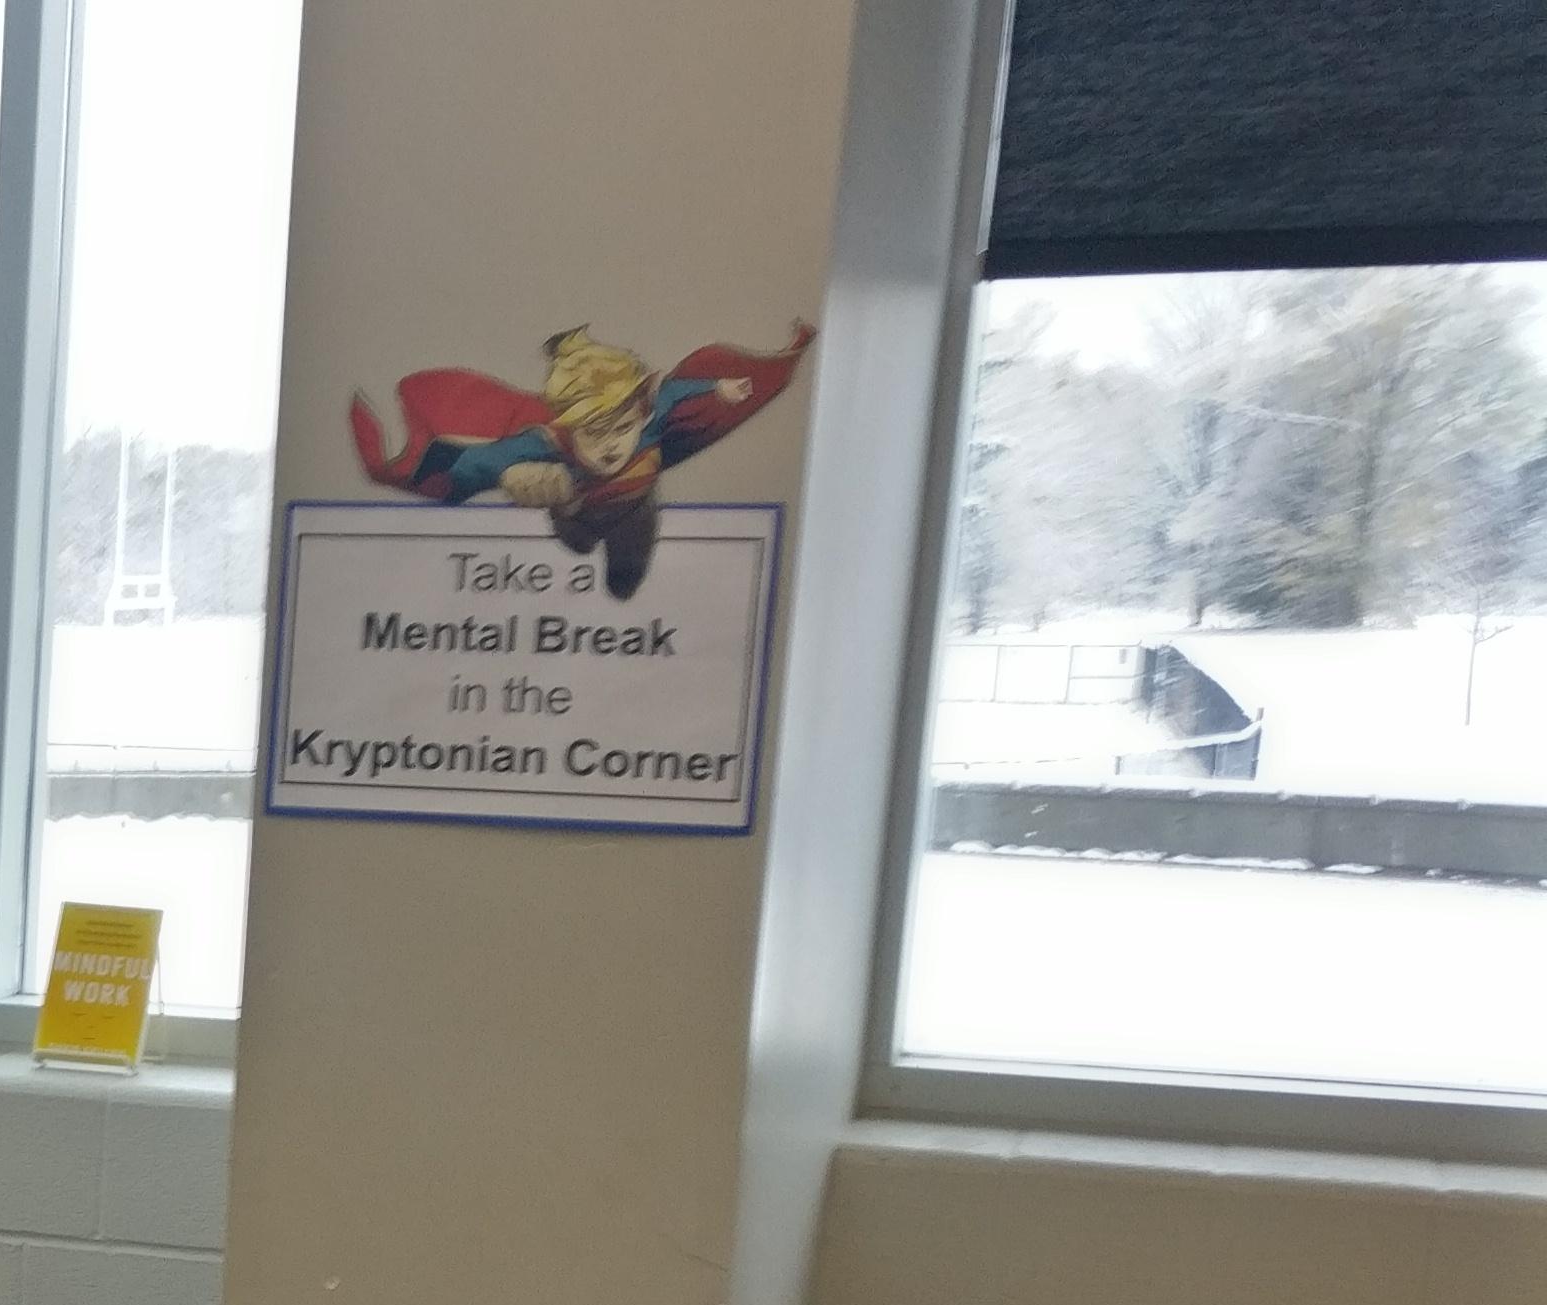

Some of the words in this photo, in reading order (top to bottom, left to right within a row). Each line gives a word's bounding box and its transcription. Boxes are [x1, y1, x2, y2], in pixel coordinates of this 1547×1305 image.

[447, 552, 553, 596] Take
[568, 563, 597, 595] a
[361, 611, 518, 657] Mental
[532, 613, 679, 658] Break
[448, 674, 487, 714] in
[501, 675, 574, 715] the
[288, 727, 547, 779] Kryptonian
[564, 736, 742, 783] Corner
[53, 950, 152, 980] MINDFUL
[64, 980, 131, 1008] WORK
